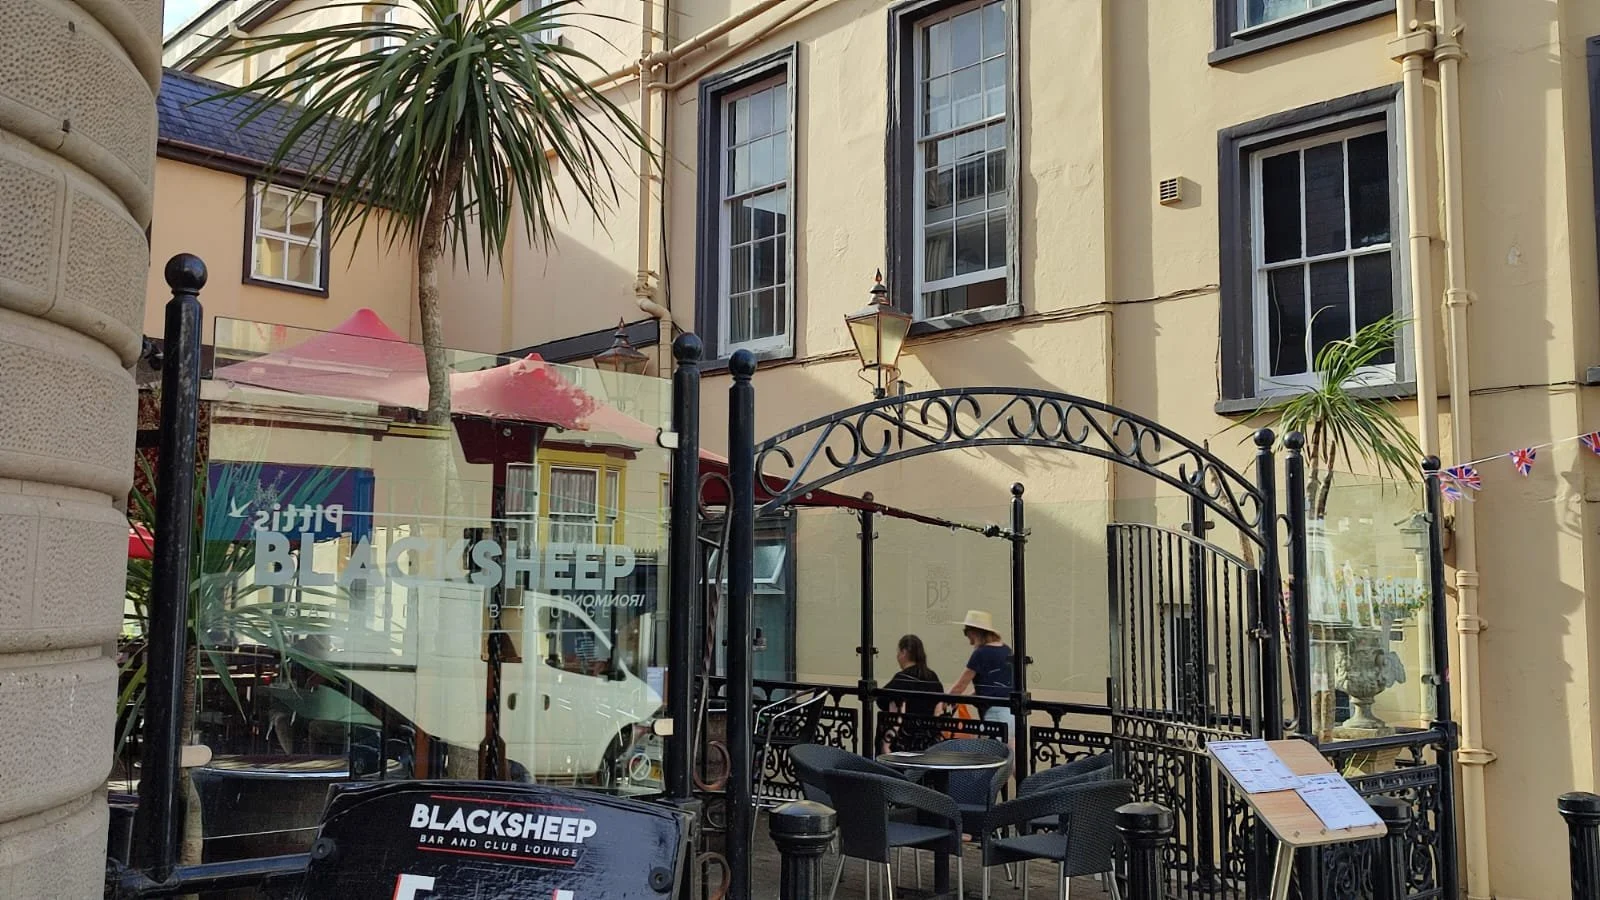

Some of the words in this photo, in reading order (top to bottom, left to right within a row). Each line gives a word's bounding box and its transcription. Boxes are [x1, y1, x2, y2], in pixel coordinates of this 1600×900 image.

[254, 531, 636, 590] BLACKSHEEP
[410, 803, 598, 844] BLACKSHEEP
[419, 834, 446, 845] BAR
[450, 836, 478, 848] AND
[484, 840, 518, 852] CLUB
[524, 844, 579, 858] LOUNGE
